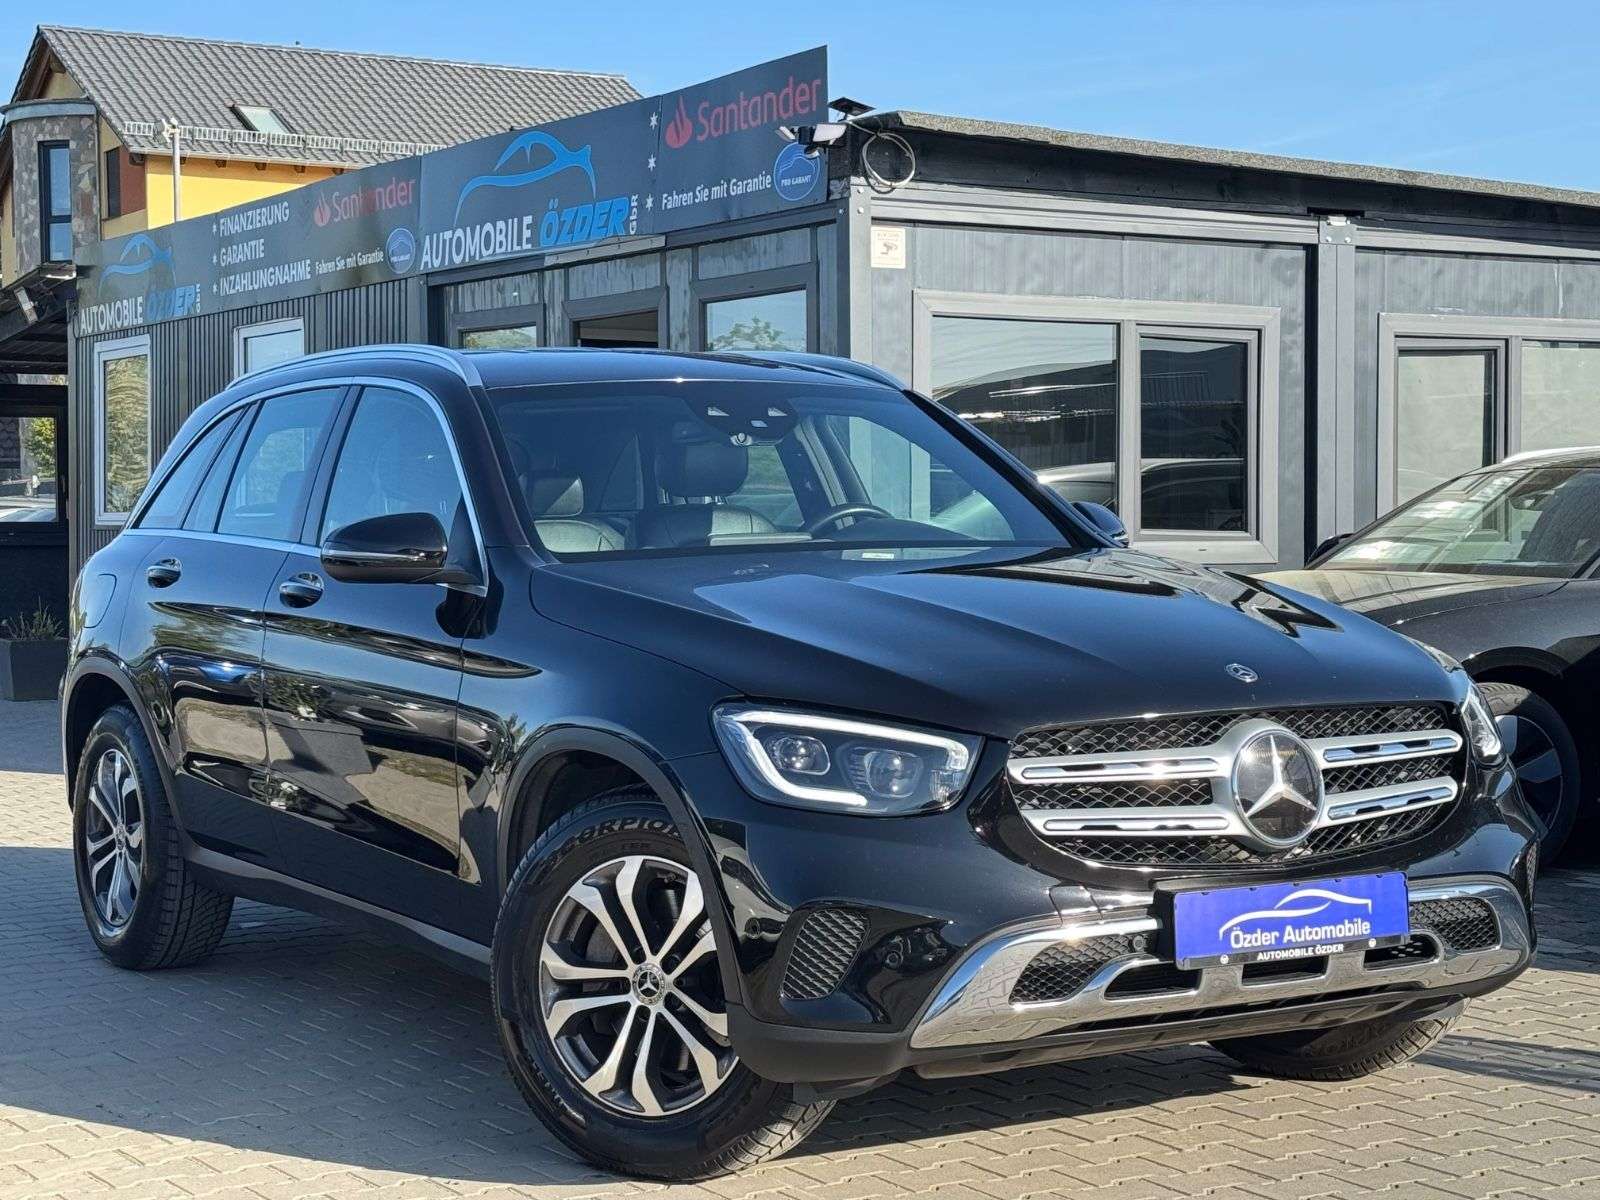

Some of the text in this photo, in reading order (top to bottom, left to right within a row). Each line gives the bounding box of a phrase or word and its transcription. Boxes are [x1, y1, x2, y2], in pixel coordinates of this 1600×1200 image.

[696, 75, 822, 142] Santander
[331, 177, 416, 223] Santnder
[661, 170, 772, 211] Fahren Sie mit Garantie
[219, 201, 290, 237] FINANZIERUNG
[420, 197, 628, 271] AUTOMOBILE ÖZDER
[220, 238, 265, 267] GARANTIE
[315, 260, 335, 275] Fahren
[336, 255, 345, 270] Sie
[346, 252, 356, 268] mit
[357, 247, 384, 266] Garantie
[220, 259, 311, 297] INZAHLUNGNAHME
[80, 296, 143, 336] AUTOMOBILE
[1231, 918, 1370, 949] Özder Automobile
[1257, 944, 1344, 960] AUTOMOBILE ÖZDER
